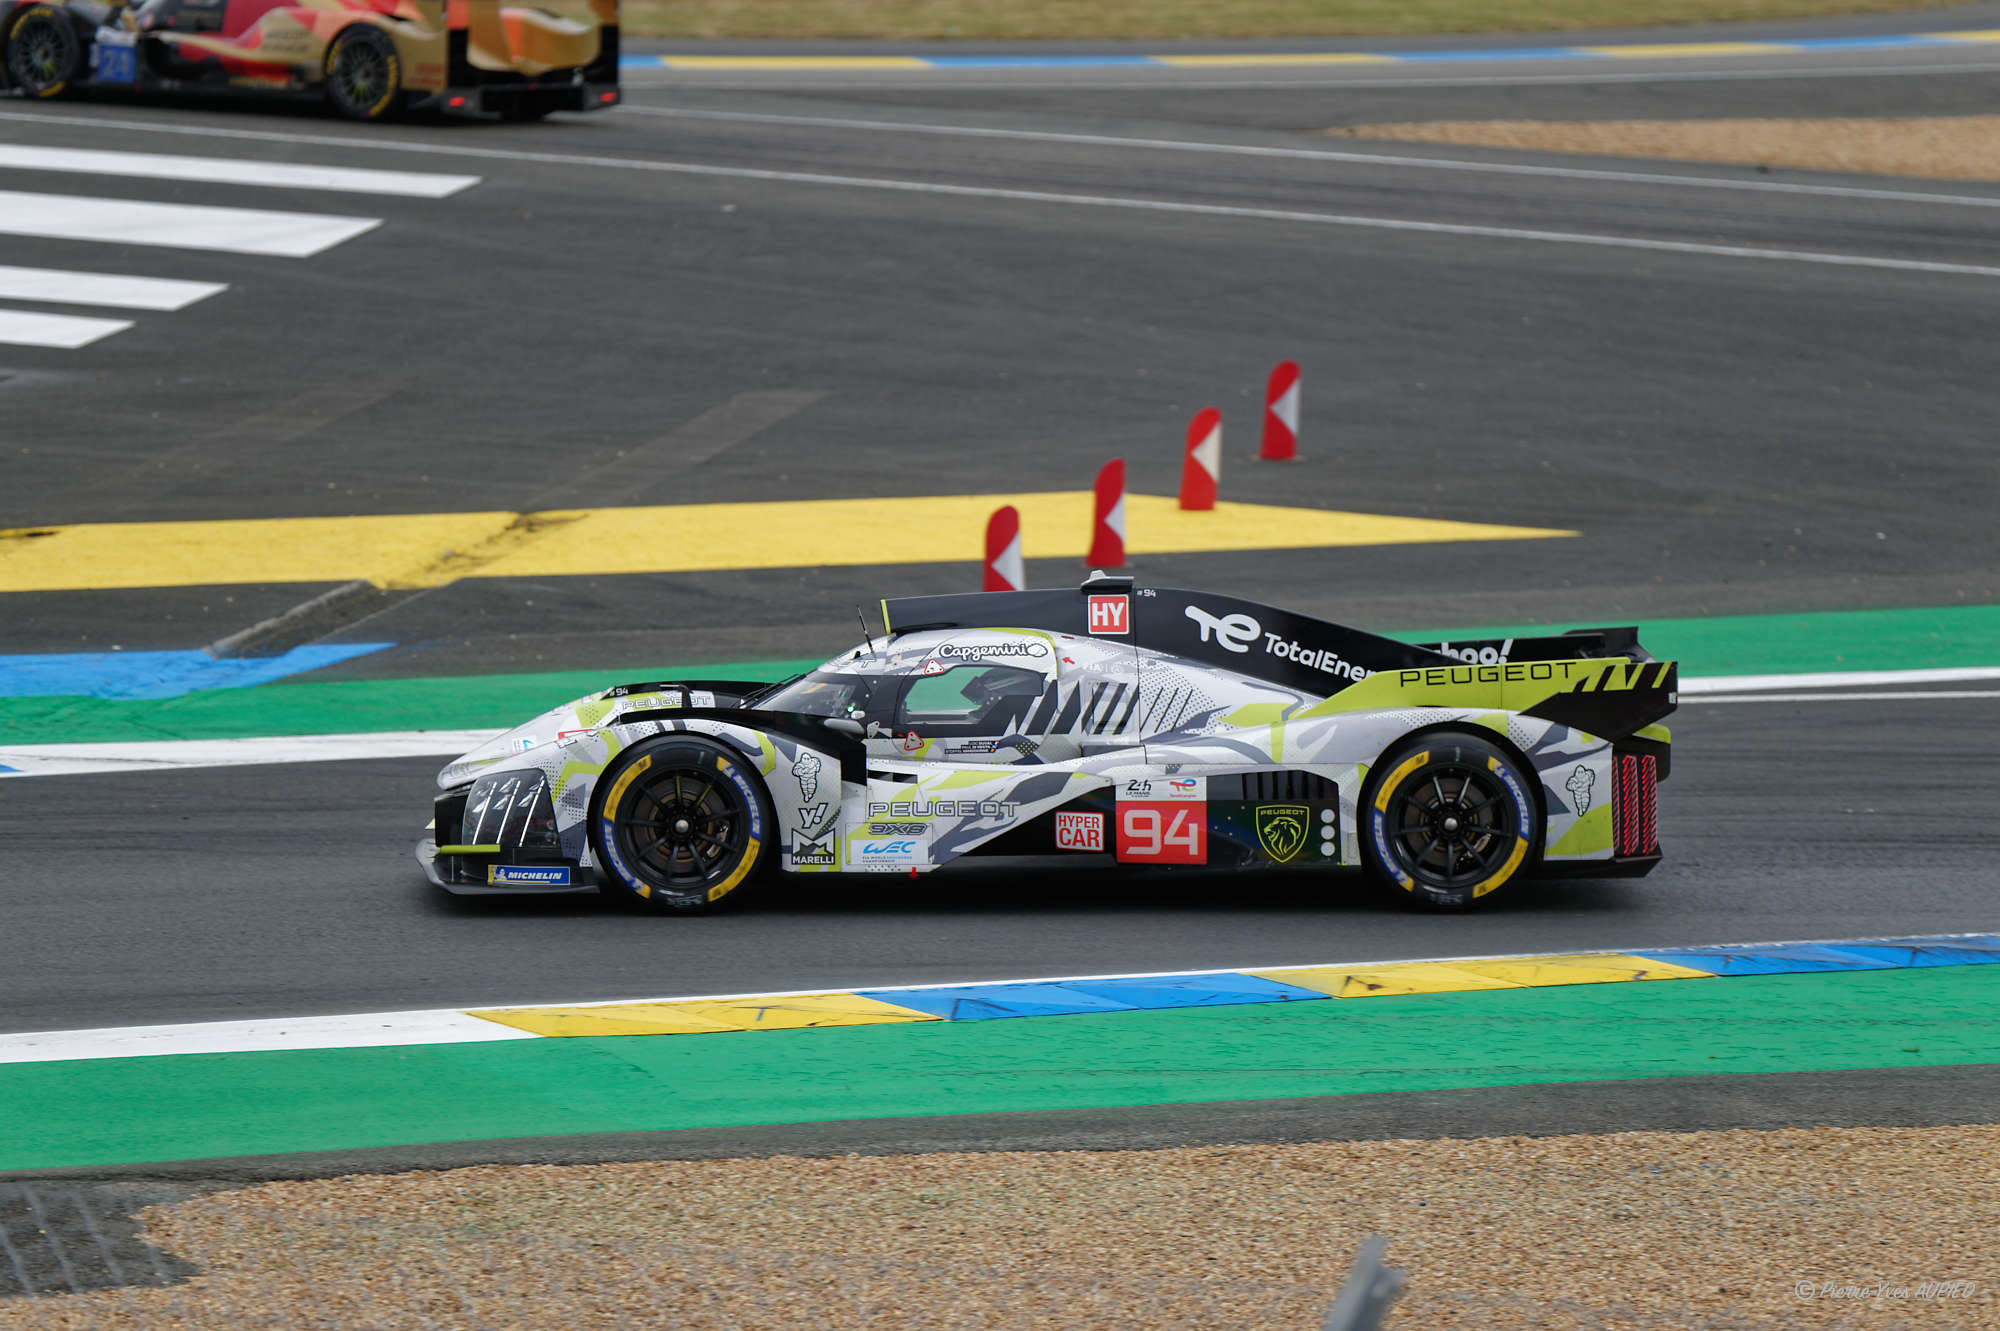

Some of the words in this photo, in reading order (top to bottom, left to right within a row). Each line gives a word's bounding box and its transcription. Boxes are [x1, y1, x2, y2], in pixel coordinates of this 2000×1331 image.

[1091, 602, 1125, 627] HY
[939, 643, 1028, 662] Capgemini
[1400, 662, 1577, 688] PEUGEOT
[868, 801, 1021, 818] PEUGEOT
[1260, 808, 1305, 816] PEUGEOT
[1058, 815, 1100, 829] HYPER
[1058, 828, 1101, 848] CAR
[1123, 809, 1199, 856] 94
[862, 840, 916, 855] WEC
[792, 855, 835, 865] MARELLI
[507, 871, 562, 880] MICHELIN
